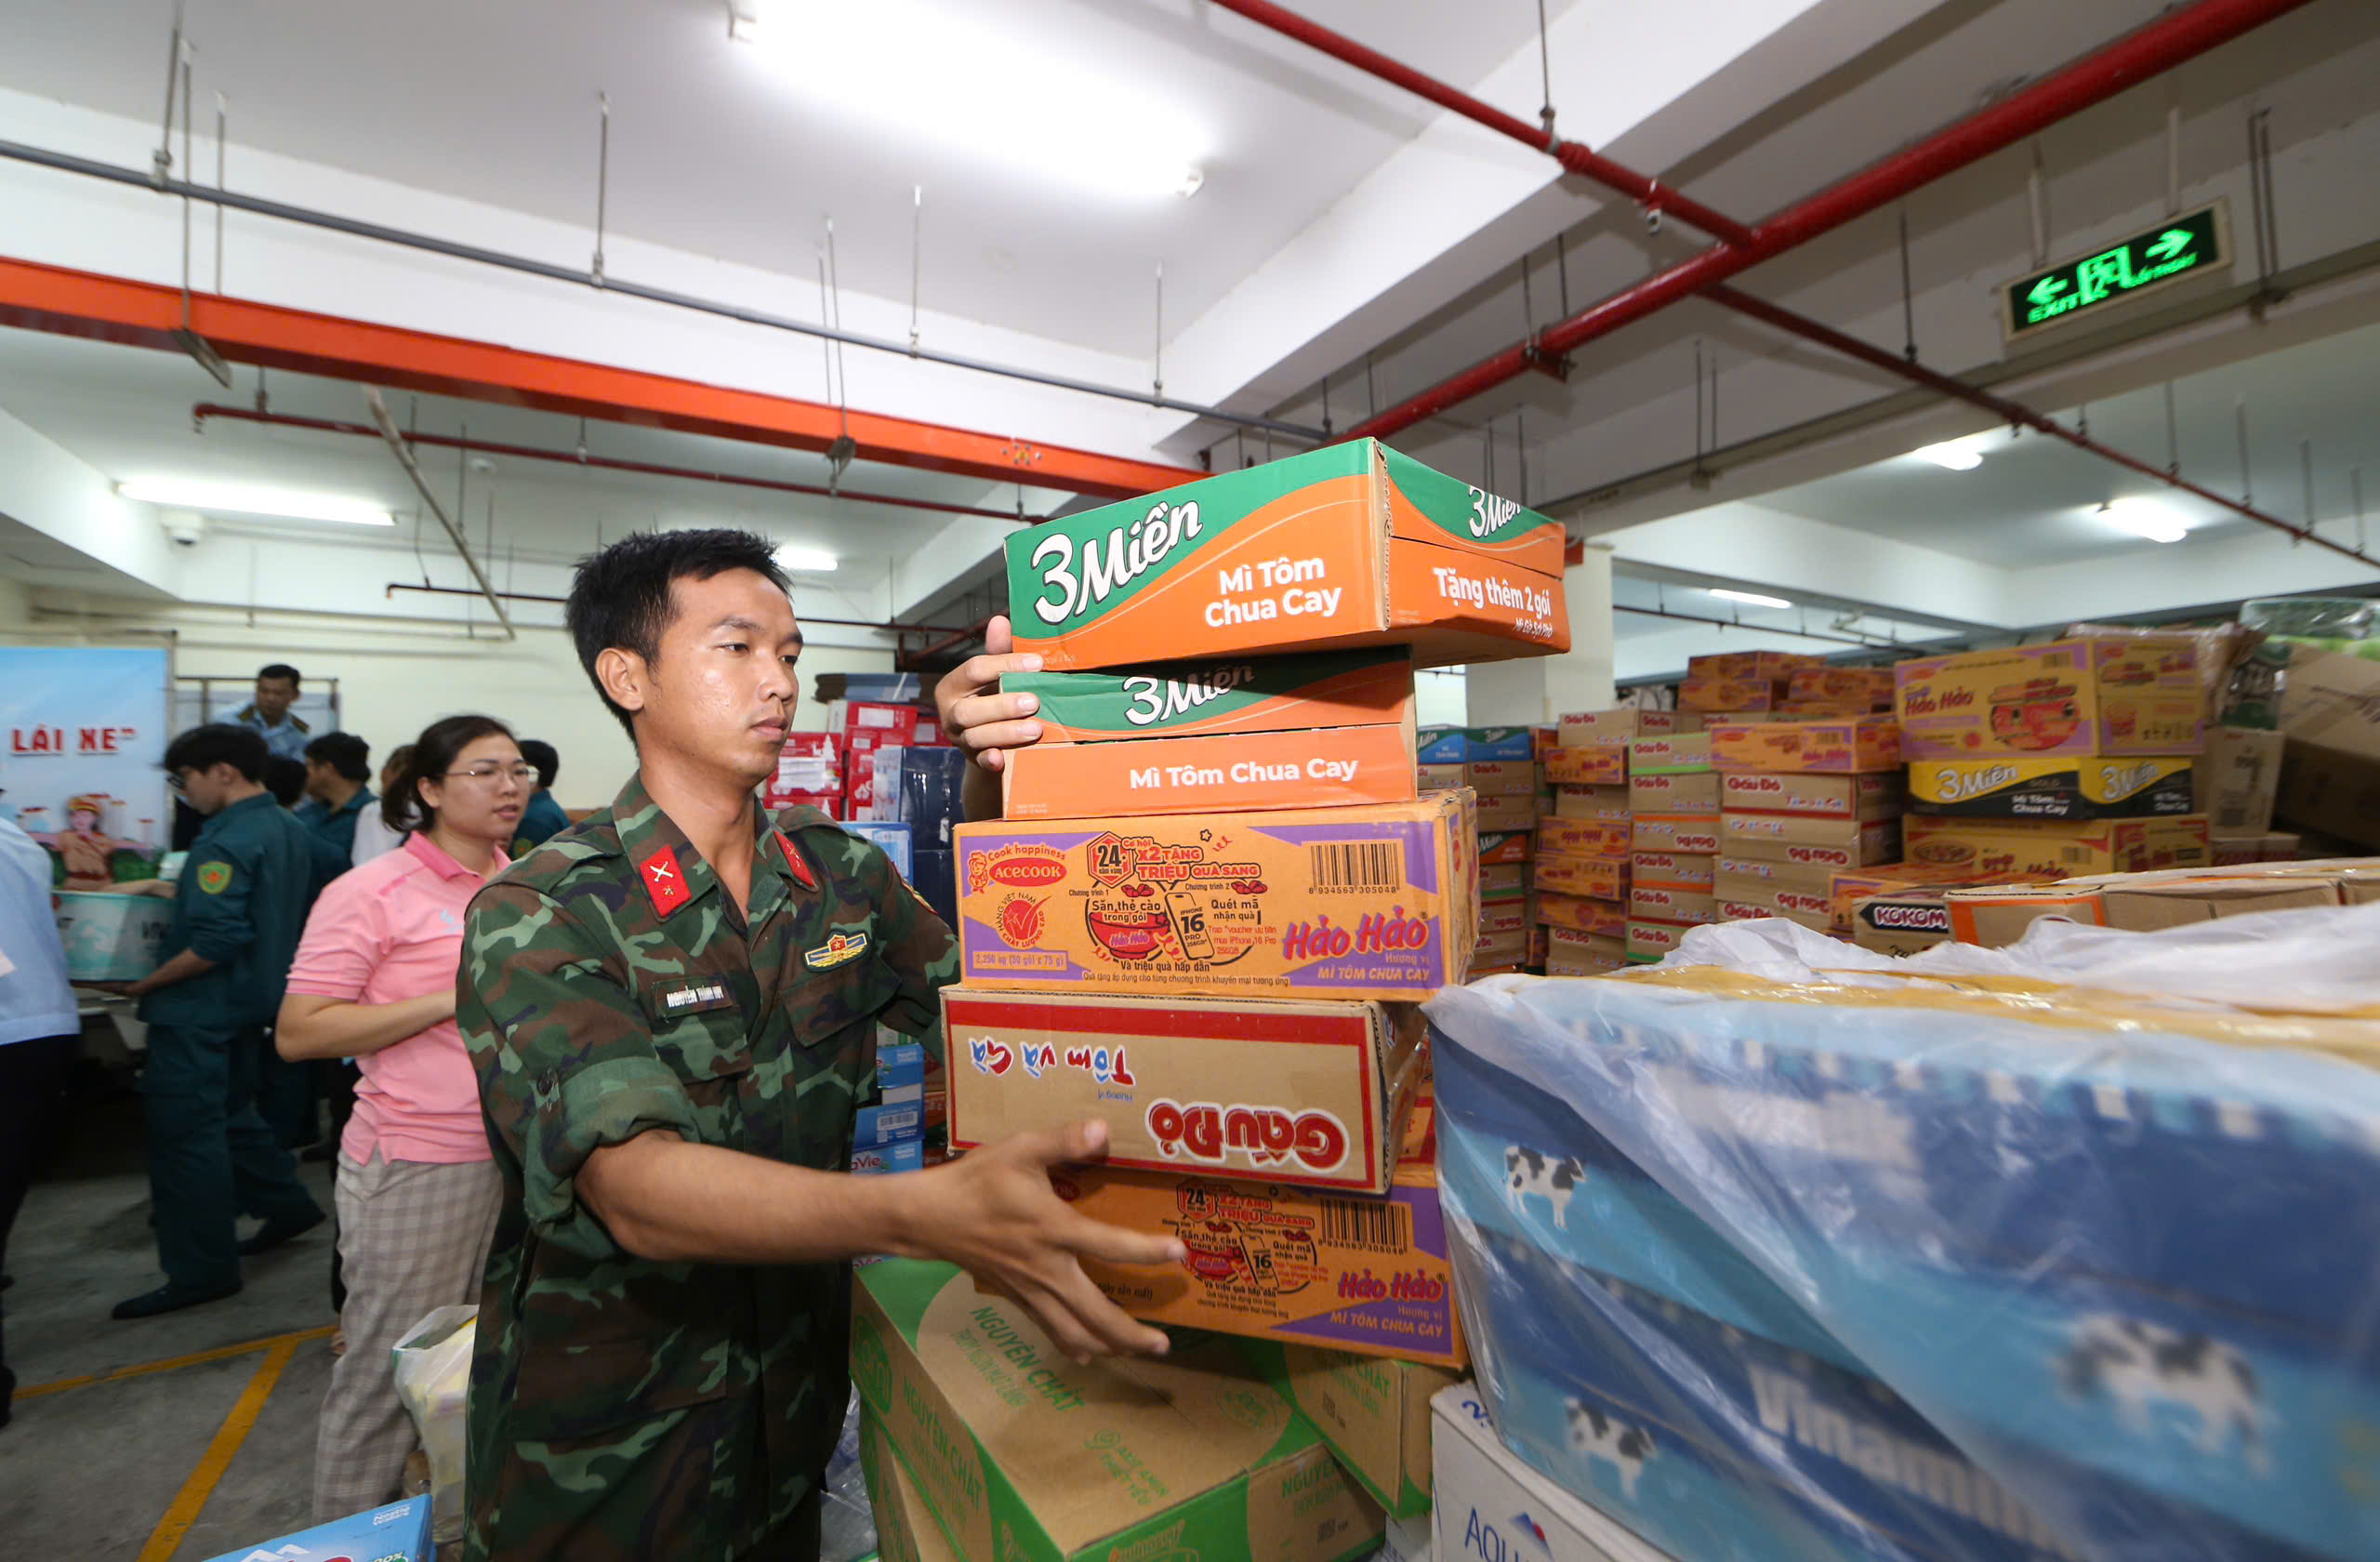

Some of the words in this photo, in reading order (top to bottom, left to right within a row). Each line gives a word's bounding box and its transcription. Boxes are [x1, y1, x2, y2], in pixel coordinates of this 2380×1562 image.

[1220, 563, 1253, 595] Mì
[1257, 556, 1325, 588] Tôm
[1433, 566, 1485, 609] Tặng
[1486, 576, 1525, 610] thêm
[1525, 586, 1534, 613] 2
[1534, 589, 1551, 620] gói
[1205, 599, 1277, 627] Chua
[1283, 587, 1342, 617] Cay
[11, 723, 64, 754] LÁI
[1130, 766, 1160, 789] Mì
[1166, 764, 1223, 788] Tôm
[1231, 761, 1300, 785] Chua
[1306, 757, 1358, 783] Cay
[988, 846, 1012, 861] Cook
[1014, 843, 1066, 860] happiness
[1098, 845, 1122, 867] 24
[1137, 865, 1189, 883] TRIỆU
[1193, 864, 1220, 877] QUÀ
[1223, 865, 1258, 877] SANG
[1117, 898, 1136, 911] thẻ
[1141, 899, 1160, 911] cào
[1211, 899, 1237, 910] Quét
[1241, 897, 1259, 909] mã
[1104, 914, 1130, 924] trong
[1132, 913, 1146, 923] gói
[1181, 914, 1205, 933] 16
[1213, 910, 1235, 921] nhận
[1238, 911, 1255, 921] quà
[1873, 906, 1949, 929] KOKOM
[1185, 933, 1201, 942] PRO
[1283, 915, 1351, 960] Hảo
[1355, 905, 1429, 954] Hảo
[1121, 960, 1132, 971] Và
[1134, 960, 1154, 972] triệu
[1157, 960, 1171, 973] quà
[1174, 960, 1191, 973] hấp
[1194, 960, 1210, 972] dẫn
[1385, 953, 1417, 965] Hương
[1318, 965, 1335, 979] MÌ
[1339, 965, 1366, 980] TÔM
[1369, 968, 1402, 980] CHUA
[1406, 968, 1430, 982] CAY
[1019, 1040, 1057, 1079] và
[1065, 1045, 1135, 1087] Tôm
[1253, 1254, 1273, 1268] 16
[1339, 1268, 1386, 1299] Hảo
[1391, 1267, 1443, 1302] Hảo
[1331, 1311, 1347, 1324] MÌ
[1351, 1313, 1378, 1329] TÔM
[1382, 1317, 1415, 1334] CHUA
[1419, 1323, 1443, 1338] CAY
